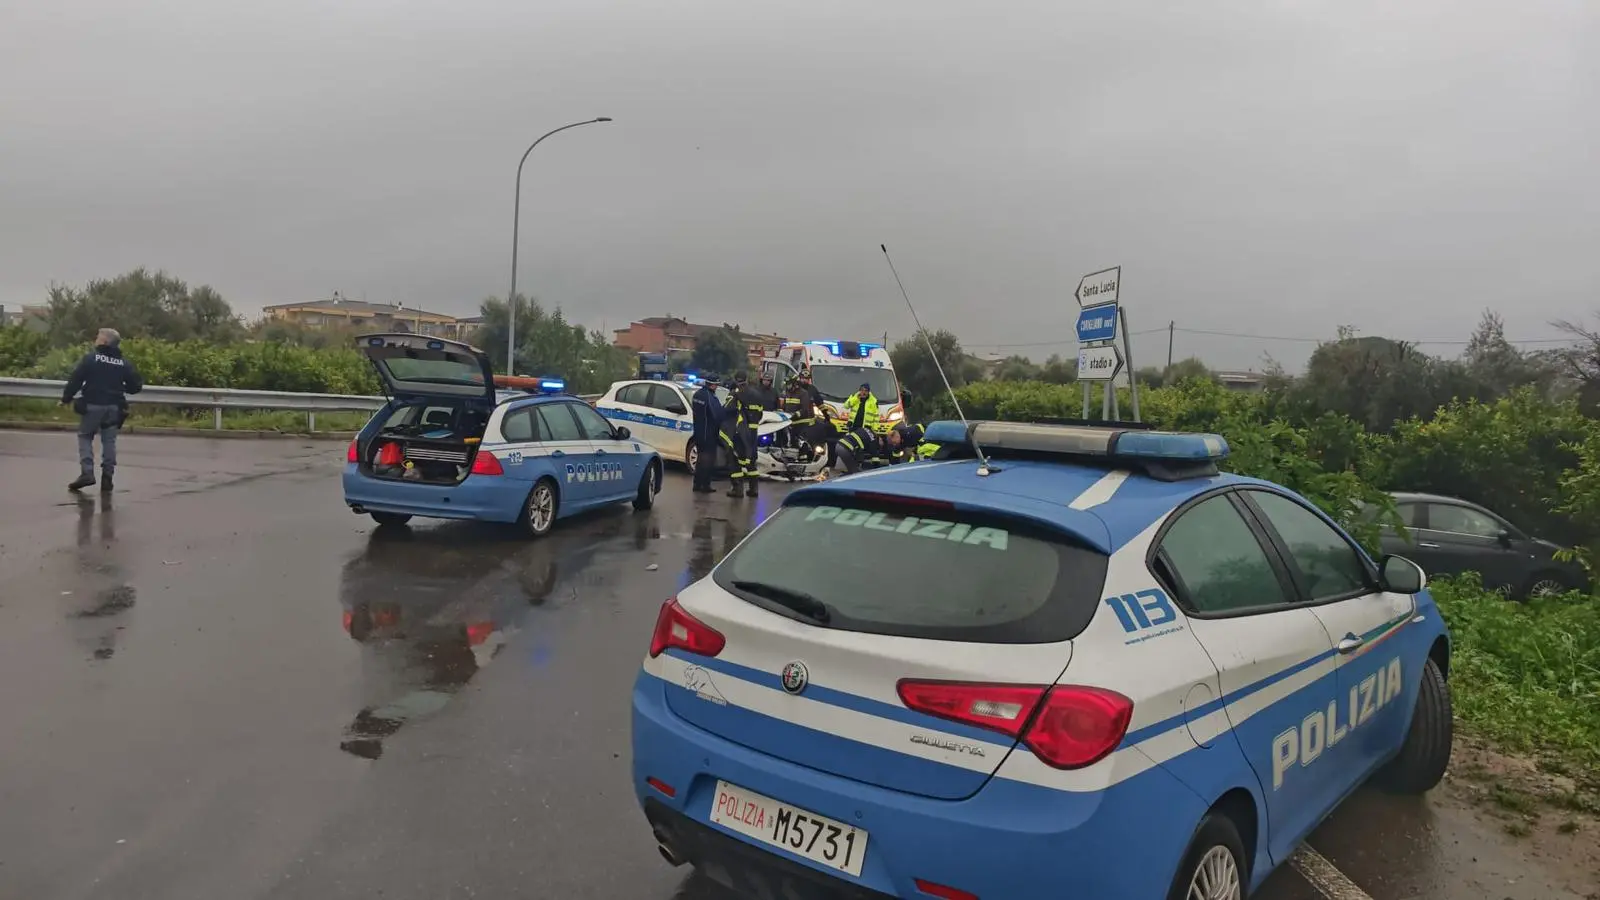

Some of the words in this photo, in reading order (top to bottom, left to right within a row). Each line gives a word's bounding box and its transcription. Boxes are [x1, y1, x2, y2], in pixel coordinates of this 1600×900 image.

[1083, 285, 1098, 297] Santa
[1100, 280, 1116, 293] Lucia
[95, 354, 124, 366] POLIZIA
[1090, 357, 1107, 369] stadio
[508, 451, 523, 463] 113
[565, 463, 623, 483] POLIZIA
[805, 506, 1009, 551] POLIZIA
[1105, 588, 1177, 633] 113
[1272, 656, 1402, 791] POLIZIA
[717, 792, 764, 830] POLIZIA
[773, 808, 855, 867] M5731
